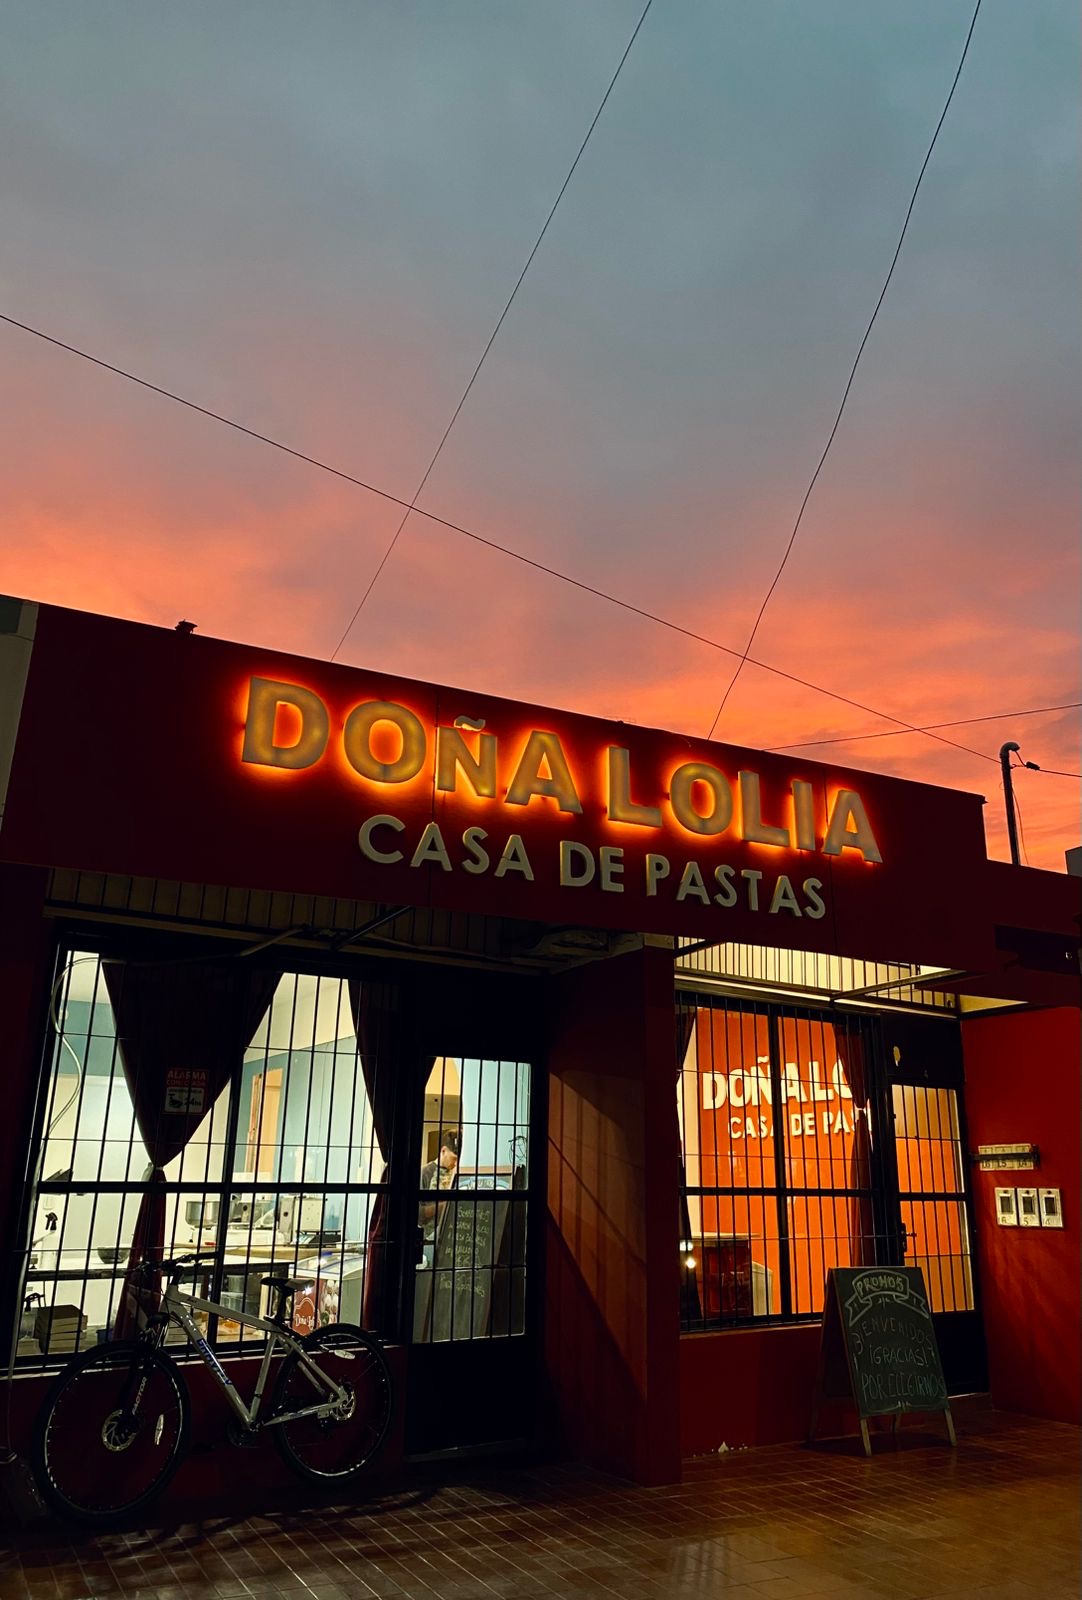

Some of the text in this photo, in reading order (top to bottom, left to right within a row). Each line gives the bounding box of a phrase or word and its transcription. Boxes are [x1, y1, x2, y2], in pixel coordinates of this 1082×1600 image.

[241, 676, 883, 864] DOÑA LOLIA
[358, 814, 826, 920] CASA DE PASTAS
[702, 1055, 808, 1110] DOÑA
[790, 1112, 815, 1137] DE
[856, 1274, 904, 1297] PROMOS
